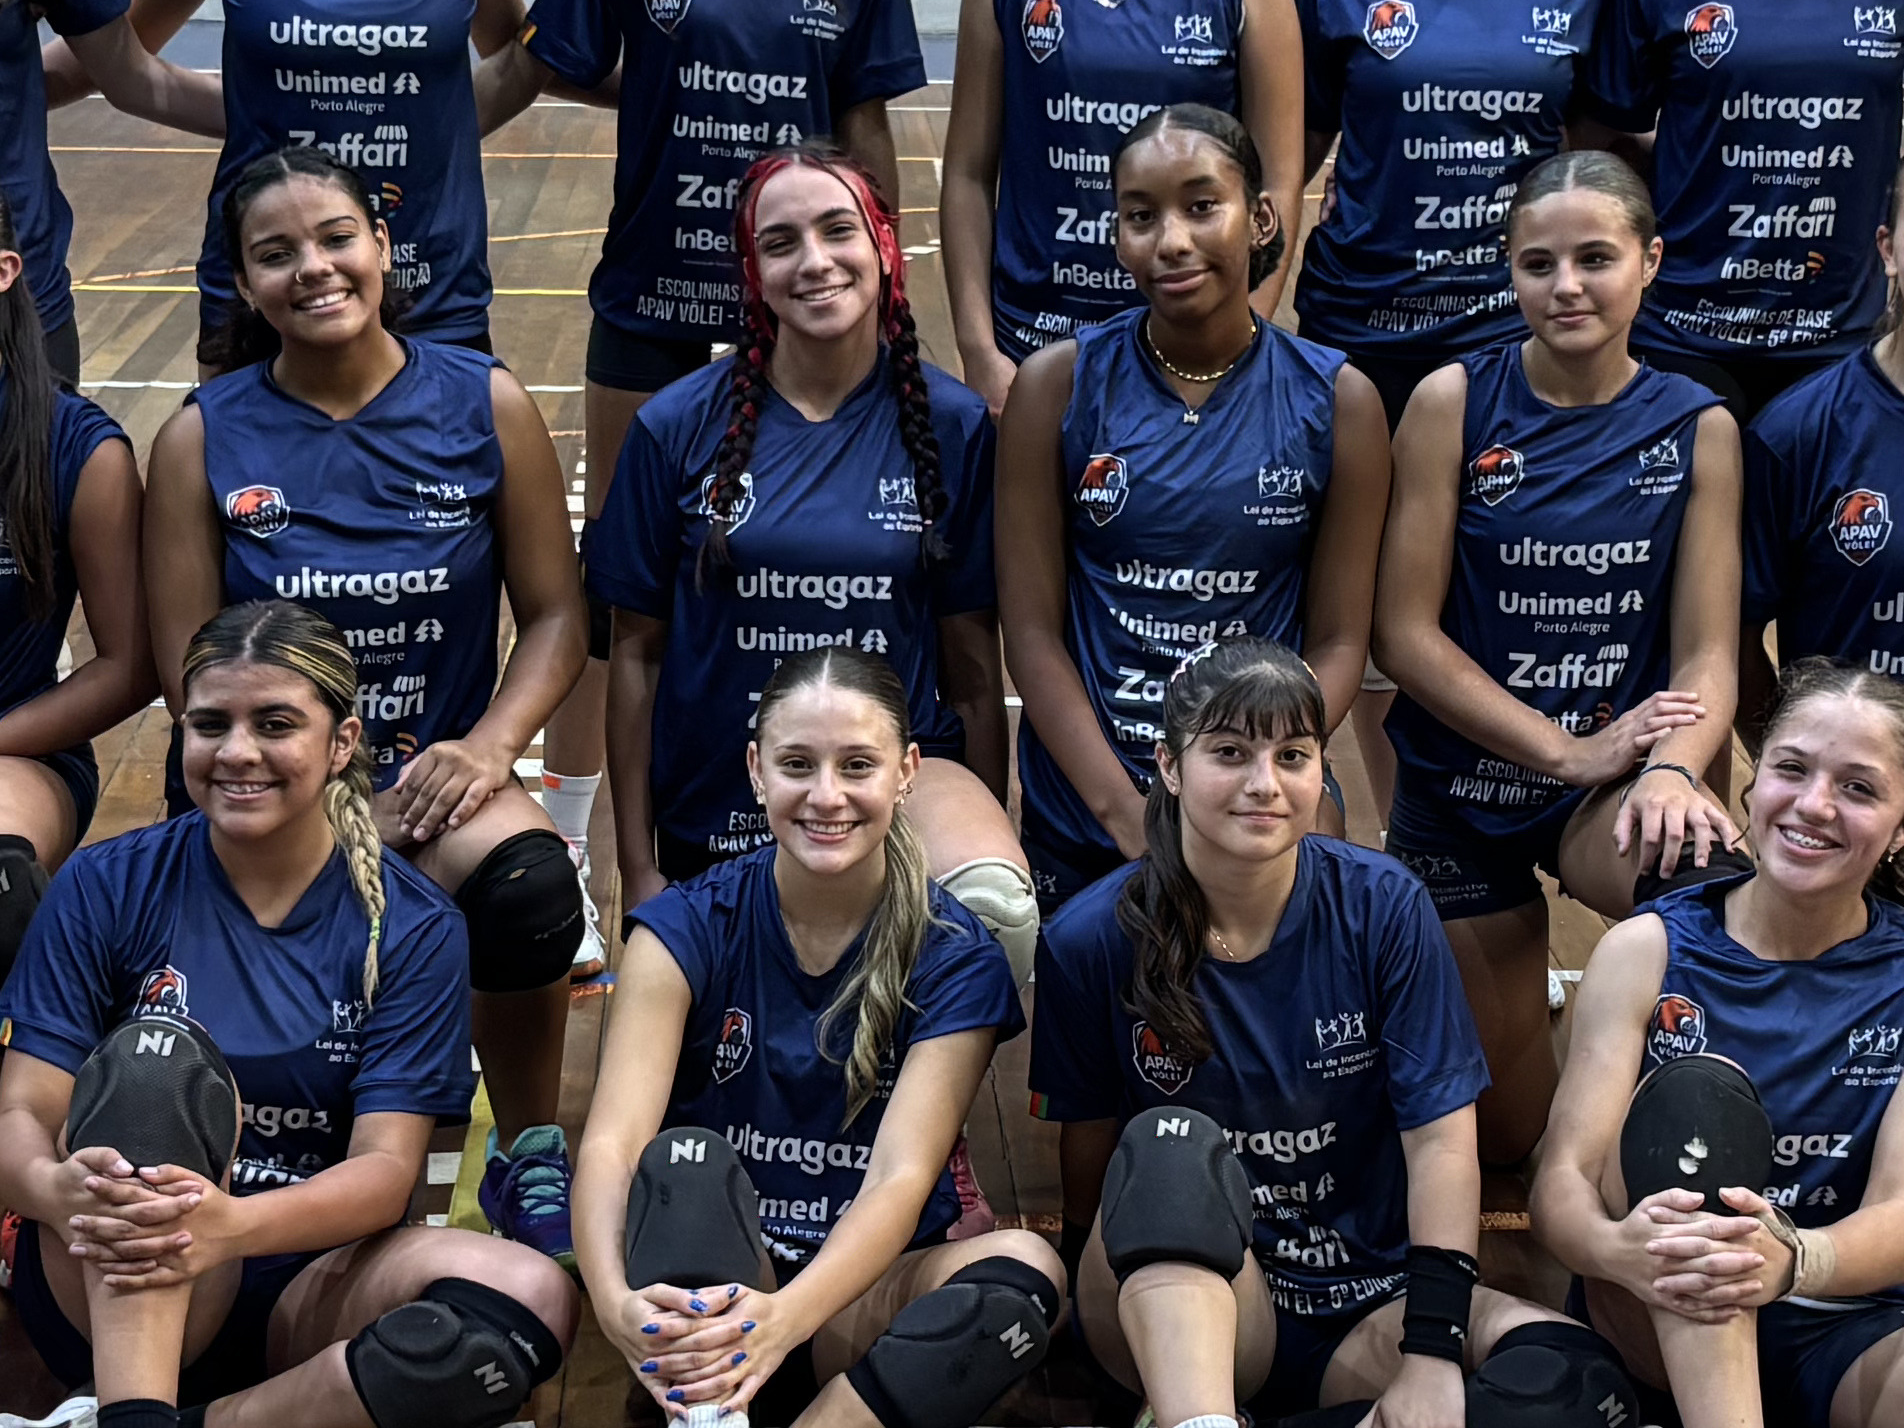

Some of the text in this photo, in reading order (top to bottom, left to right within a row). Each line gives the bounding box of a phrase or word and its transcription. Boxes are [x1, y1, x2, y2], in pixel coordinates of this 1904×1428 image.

[269, 16, 428, 56] ultragaz
[1372, 27, 1410, 40] APAV
[1694, 32, 1728, 48] APAV
[275, 68, 385, 94] Unimed
[679, 61, 807, 105] ultragaz
[311, 99, 385, 115] Porto Alegre
[1402, 83, 1543, 121] ultragaz
[1722, 91, 1864, 129] ultragaz
[674, 113, 768, 143] Unimed
[702, 145, 730, 158] Porto
[1404, 135, 1505, 160] Unimed
[1722, 145, 1824, 168] Unimed
[1075, 177, 1104, 189] Porto
[1436, 164, 1505, 178] Porto Alegre
[1752, 174, 1821, 188] Porto Alegre
[1728, 196, 1836, 239] Zaffari
[1052, 261, 1137, 290] InBetta
[1721, 257, 1805, 281] InBetta
[657, 277, 739, 302] ESCOLINHAS
[637, 295, 674, 321] APAV
[1776, 310, 1833, 329] DE BASE
[1080, 488, 1119, 503] APAV
[1839, 524, 1881, 540] APAV
[1500, 537, 1651, 575] ultragaz
[276, 567, 449, 604] ultragaz
[736, 568, 893, 609] ultragaz
[1115, 559, 1259, 601] ultragaz
[1499, 591, 1611, 615] Unimed
[737, 628, 853, 652] Unimed
[1534, 622, 1610, 635] Porto Alegre
[363, 651, 405, 665] Alegre
[1450, 775, 1493, 802] APAV
[135, 1030, 177, 1057] N1
[1654, 1030, 1696, 1052] APAV
[1157, 1118, 1190, 1136] N1
[670, 1139, 706, 1163] N1
[727, 1123, 873, 1175] ultragaz
[998, 1321, 1035, 1360] N1
[474, 1361, 510, 1394] N1
